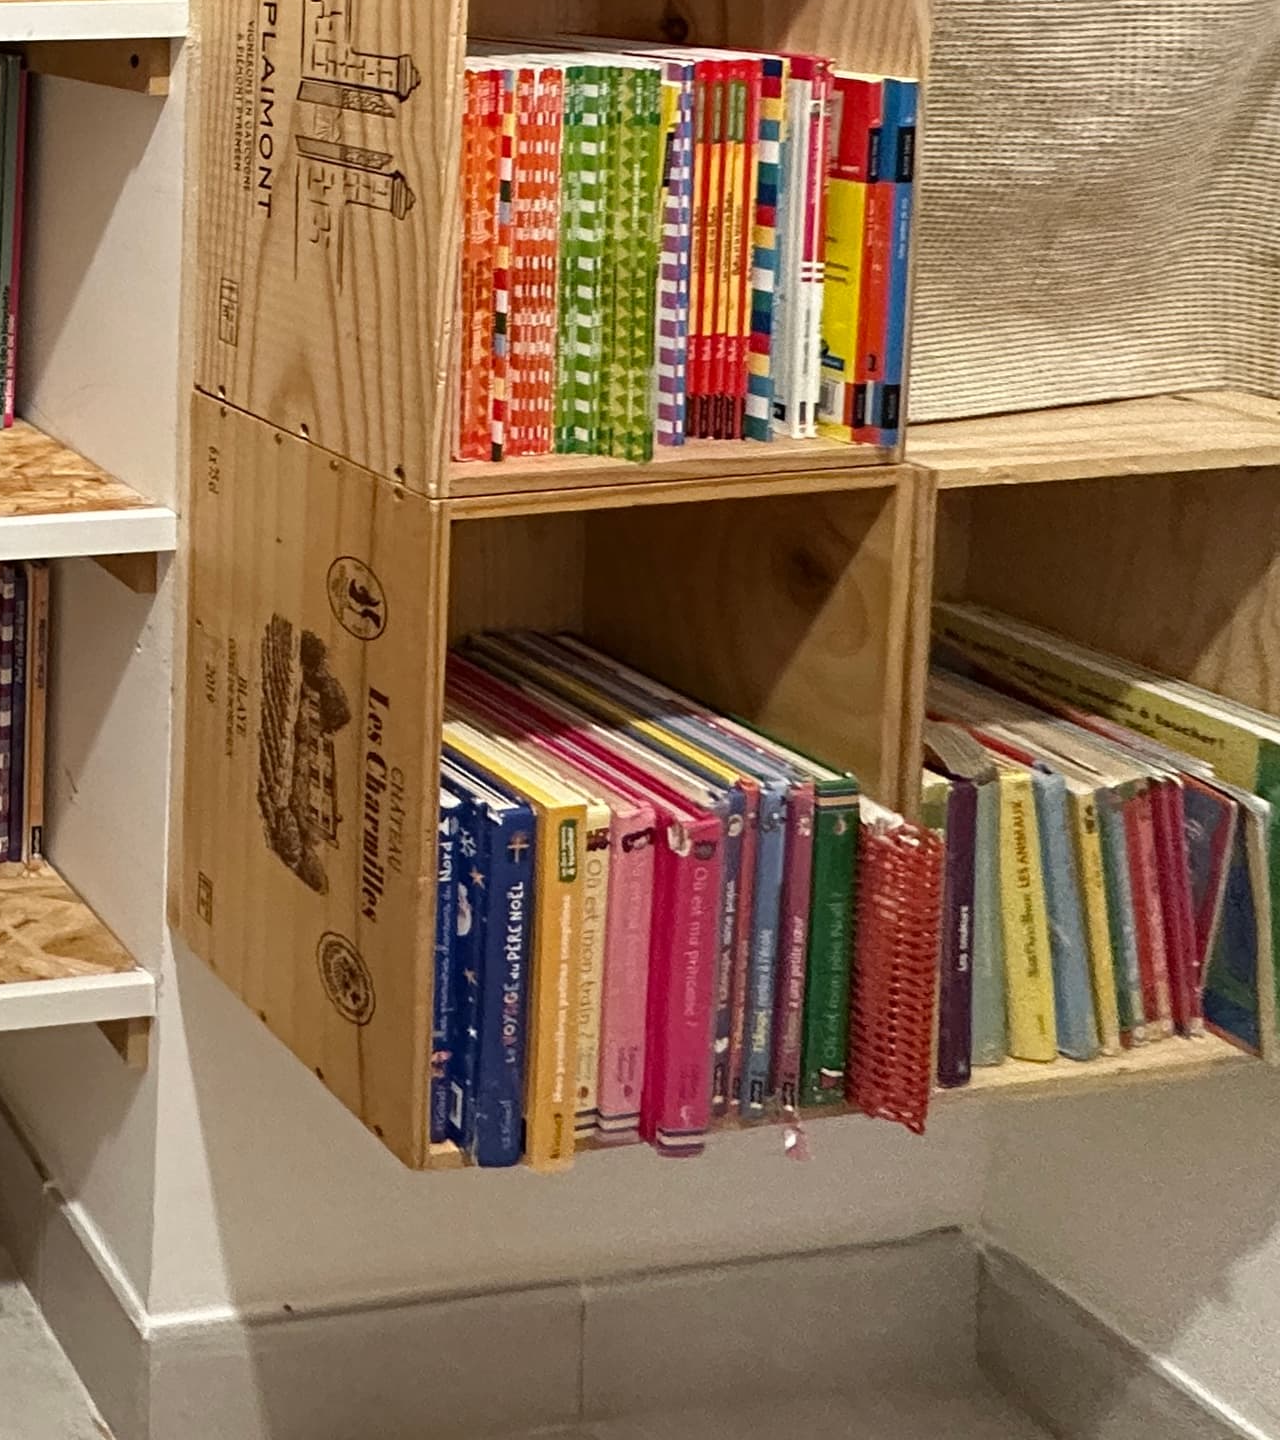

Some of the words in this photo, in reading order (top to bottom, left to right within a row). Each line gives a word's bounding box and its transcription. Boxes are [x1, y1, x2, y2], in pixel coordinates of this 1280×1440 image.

[257, 1, 278, 220] PLAIMONT
[205, 662, 217, 705] 2019
[236, 672, 248, 738] BLAYE
[365, 685, 391, 745] Les
[359, 751, 390, 924] Charmilles
[438, 841, 454, 882] Nord
[505, 882, 525, 922] NOËL
[502, 924, 523, 962] PÈRE
